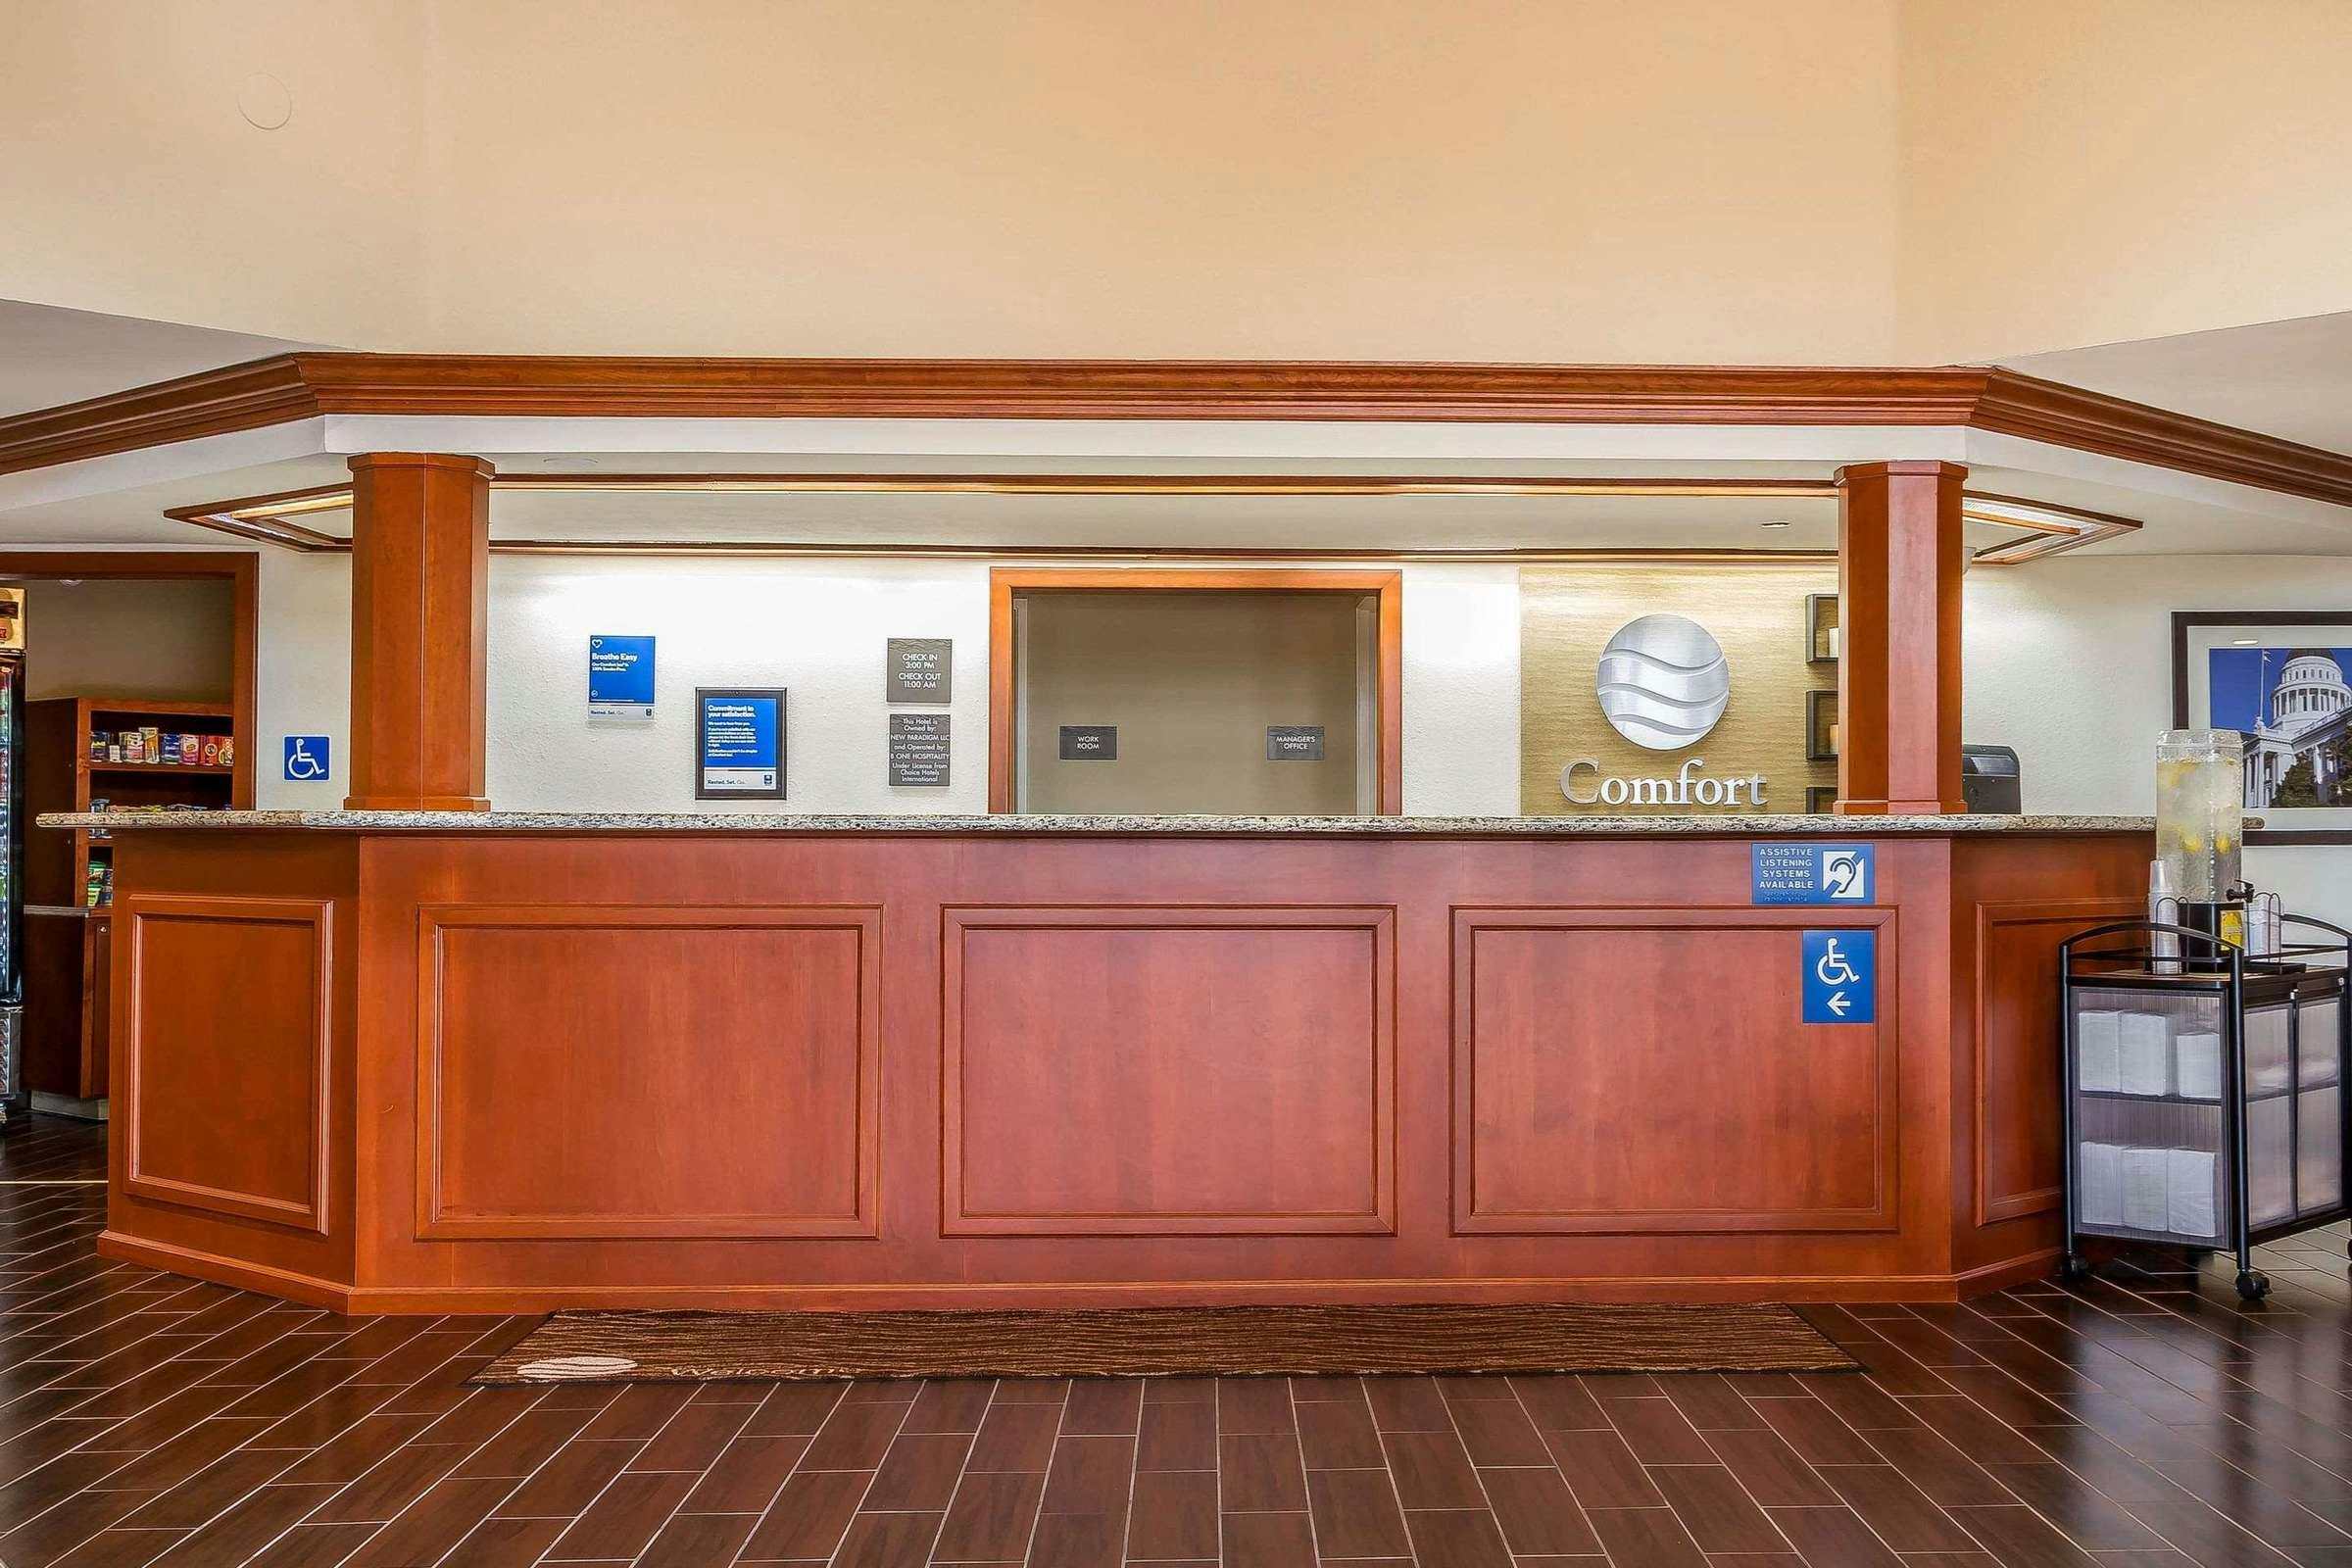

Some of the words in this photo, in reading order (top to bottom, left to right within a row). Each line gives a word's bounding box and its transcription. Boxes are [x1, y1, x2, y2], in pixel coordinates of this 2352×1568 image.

[620, 653, 637, 662] Easy
[898, 672, 923, 681] CHECK
[925, 672, 941, 681] OUT
[1559, 758, 1768, 806] Comfort
